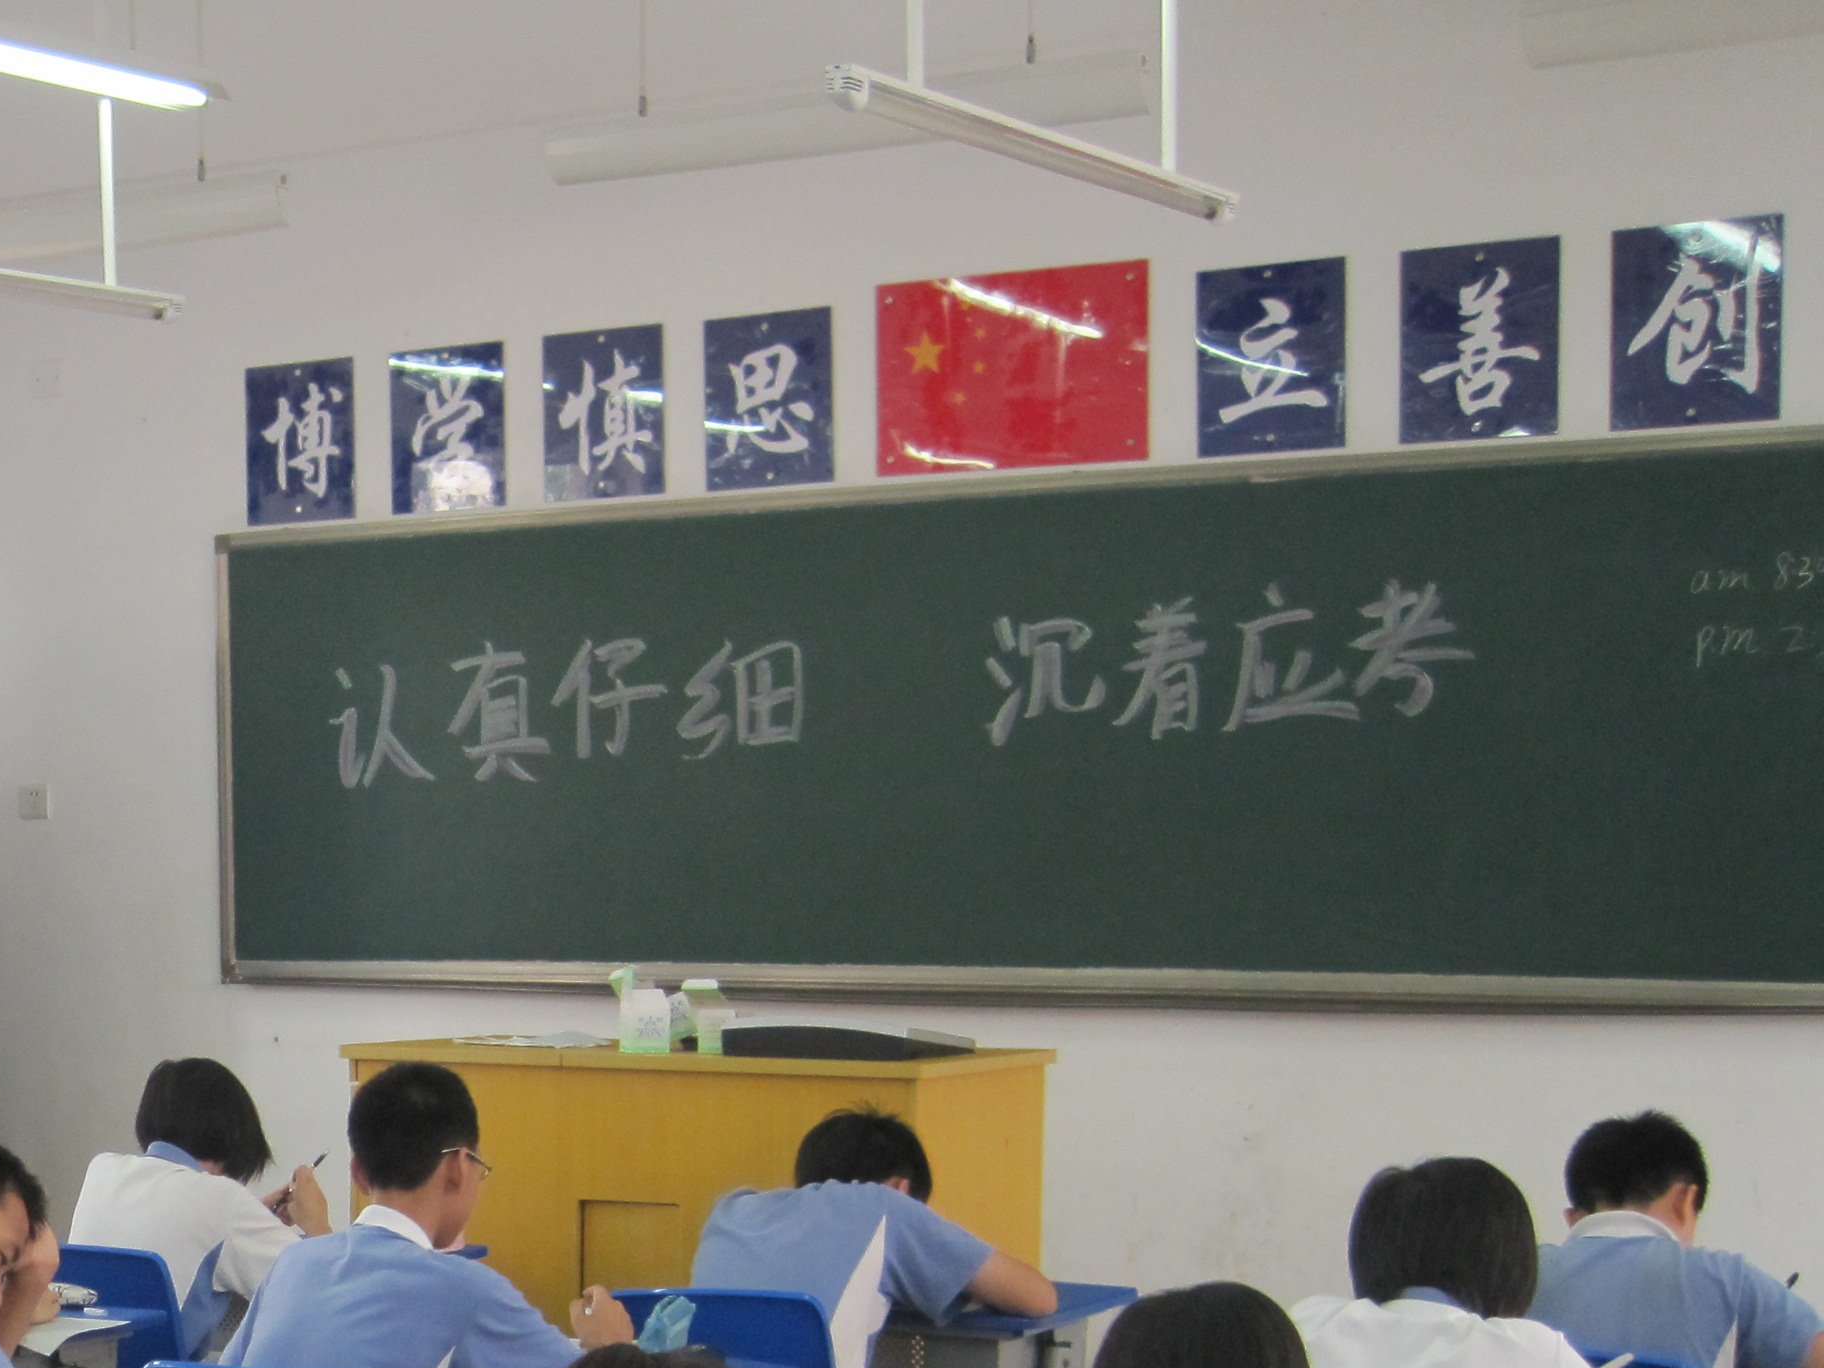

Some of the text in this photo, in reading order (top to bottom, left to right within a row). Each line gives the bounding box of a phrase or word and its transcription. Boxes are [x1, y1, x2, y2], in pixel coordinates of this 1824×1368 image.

[329, 579, 1476, 790] 认真仔细 沉着应考
